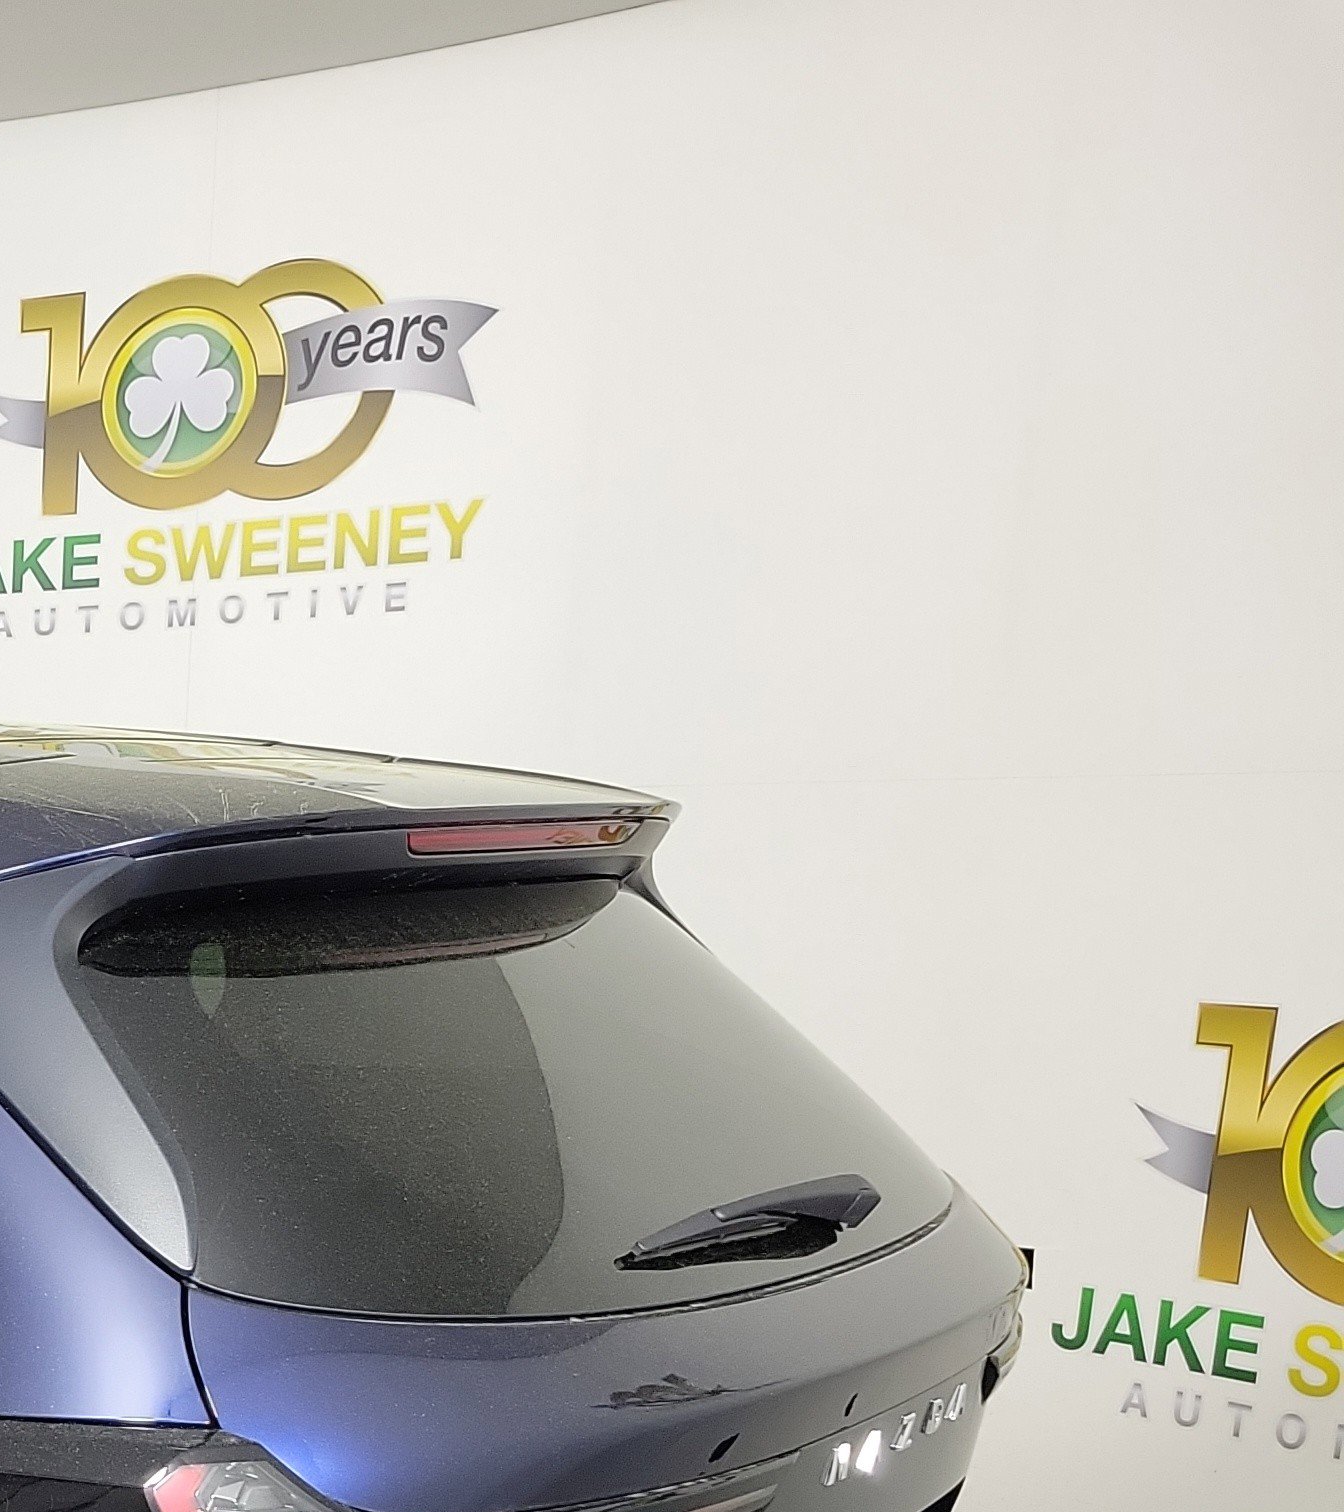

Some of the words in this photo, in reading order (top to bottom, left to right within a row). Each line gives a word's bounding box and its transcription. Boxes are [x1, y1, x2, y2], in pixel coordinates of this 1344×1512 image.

[297, 311, 448, 392] years
[123, 499, 485, 586] SWEENEY
[1051, 1287, 1265, 1384] JAKE
